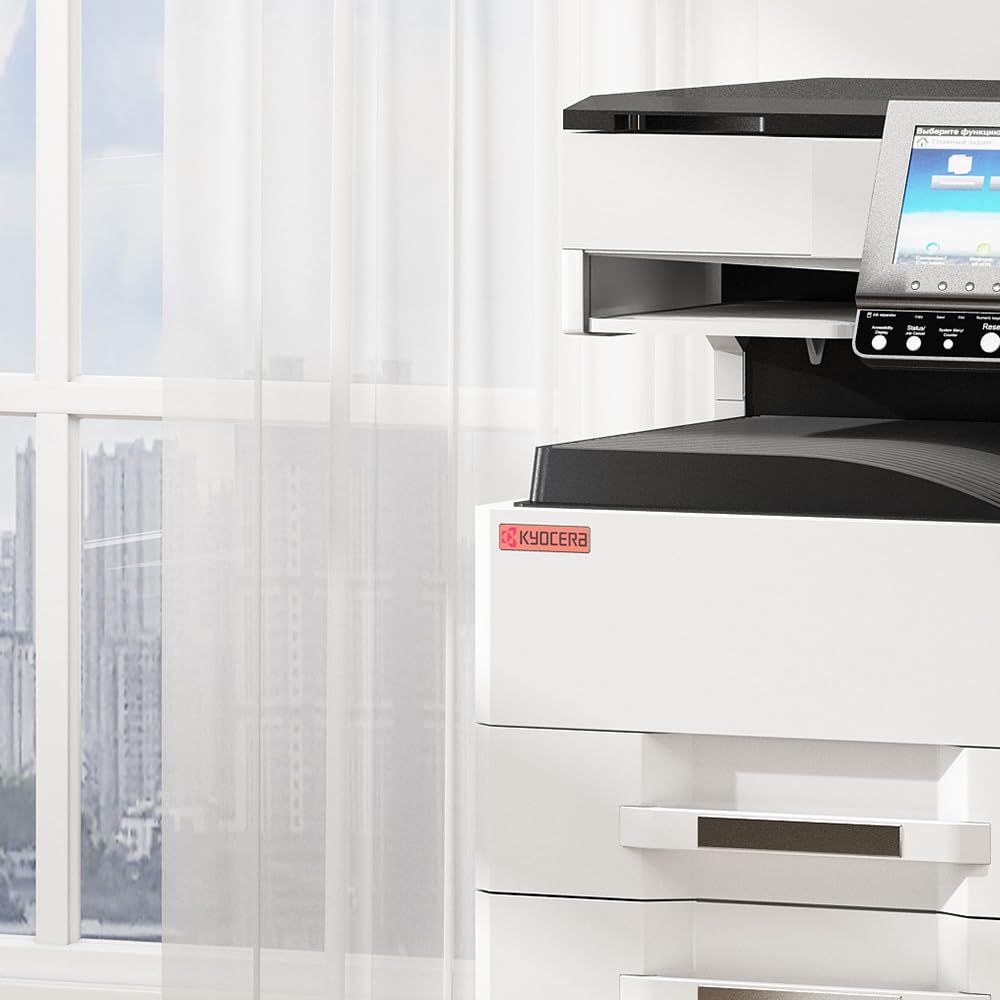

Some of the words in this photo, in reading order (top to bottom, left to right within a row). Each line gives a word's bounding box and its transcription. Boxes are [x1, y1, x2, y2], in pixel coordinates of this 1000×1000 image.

[916, 127, 959, 136] Выберите
[906, 324, 927, 332] Status/
[519, 530, 588, 547] KYOCERA
